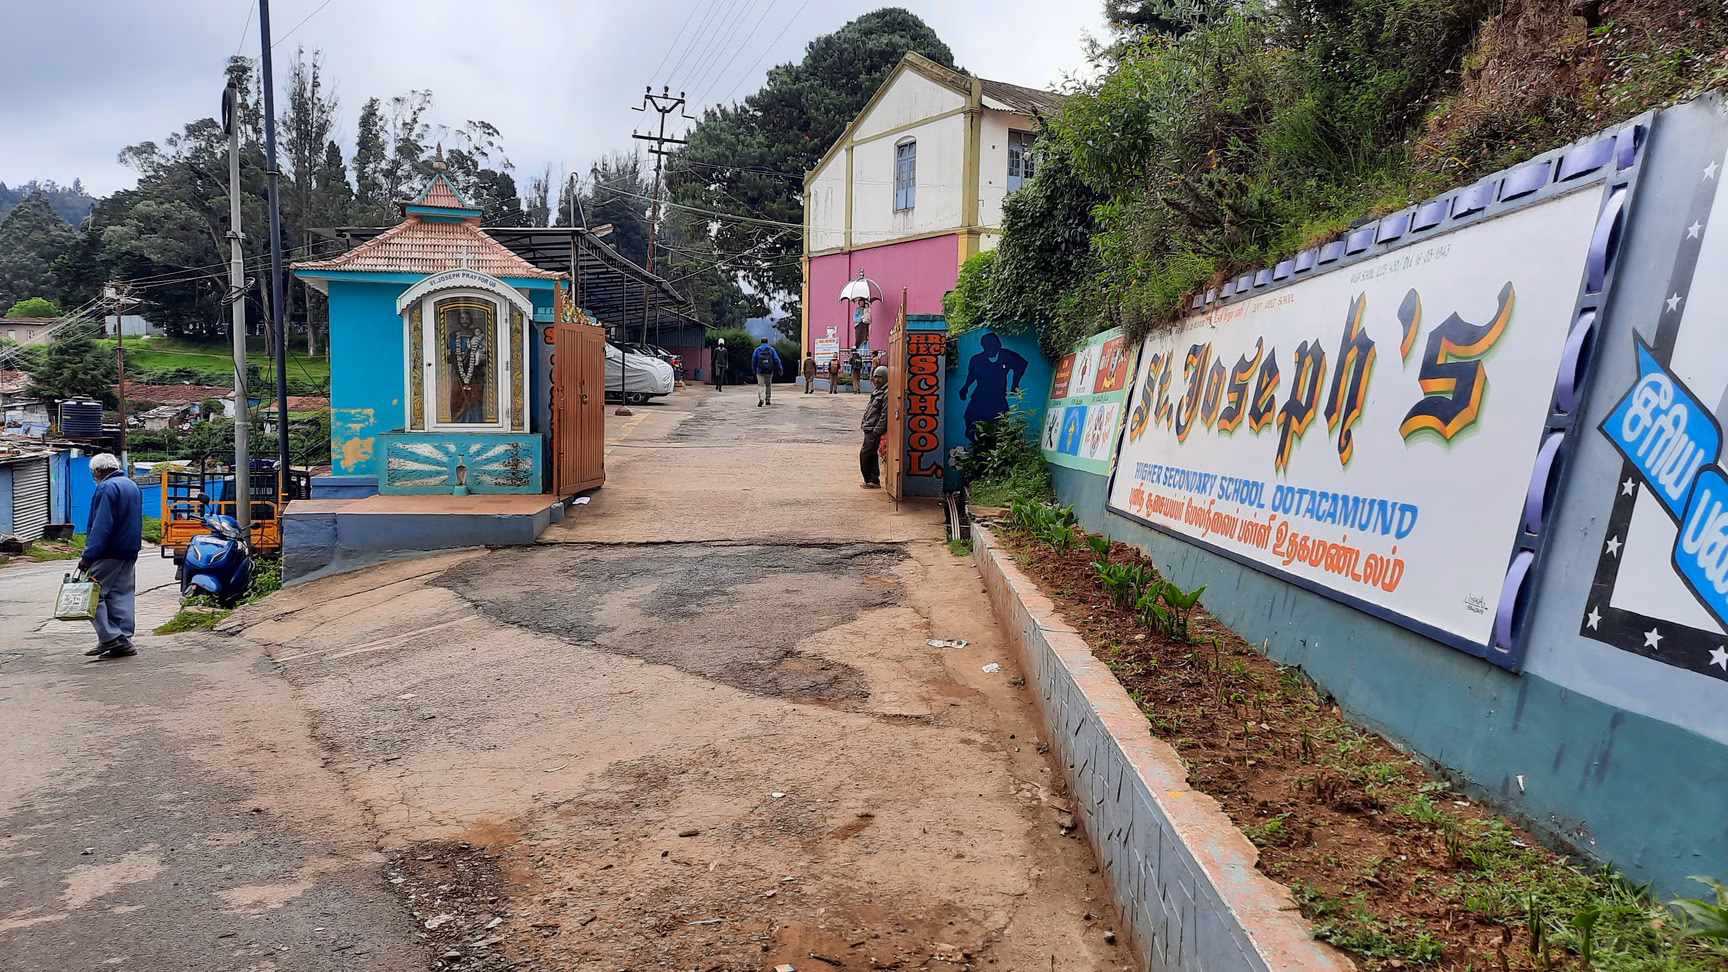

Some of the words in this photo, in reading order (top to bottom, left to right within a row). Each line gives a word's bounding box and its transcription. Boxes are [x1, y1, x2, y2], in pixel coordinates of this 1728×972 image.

[461, 272, 477, 281] PRAY
[477, 276, 489, 285] FOR
[488, 280, 497, 288] US
[1622, 372, 1705, 500] சீரிய
[1134, 461, 1162, 483] HIGHER
[1162, 466, 1217, 497] SECONDARY
[1217, 475, 1265, 509] SCHOOL
[1271, 484, 1419, 540] OOTACAMUND
[1237, 508, 1277, 550] பள்ளி
[1272, 520, 1406, 593] உதகமண்டலம்
